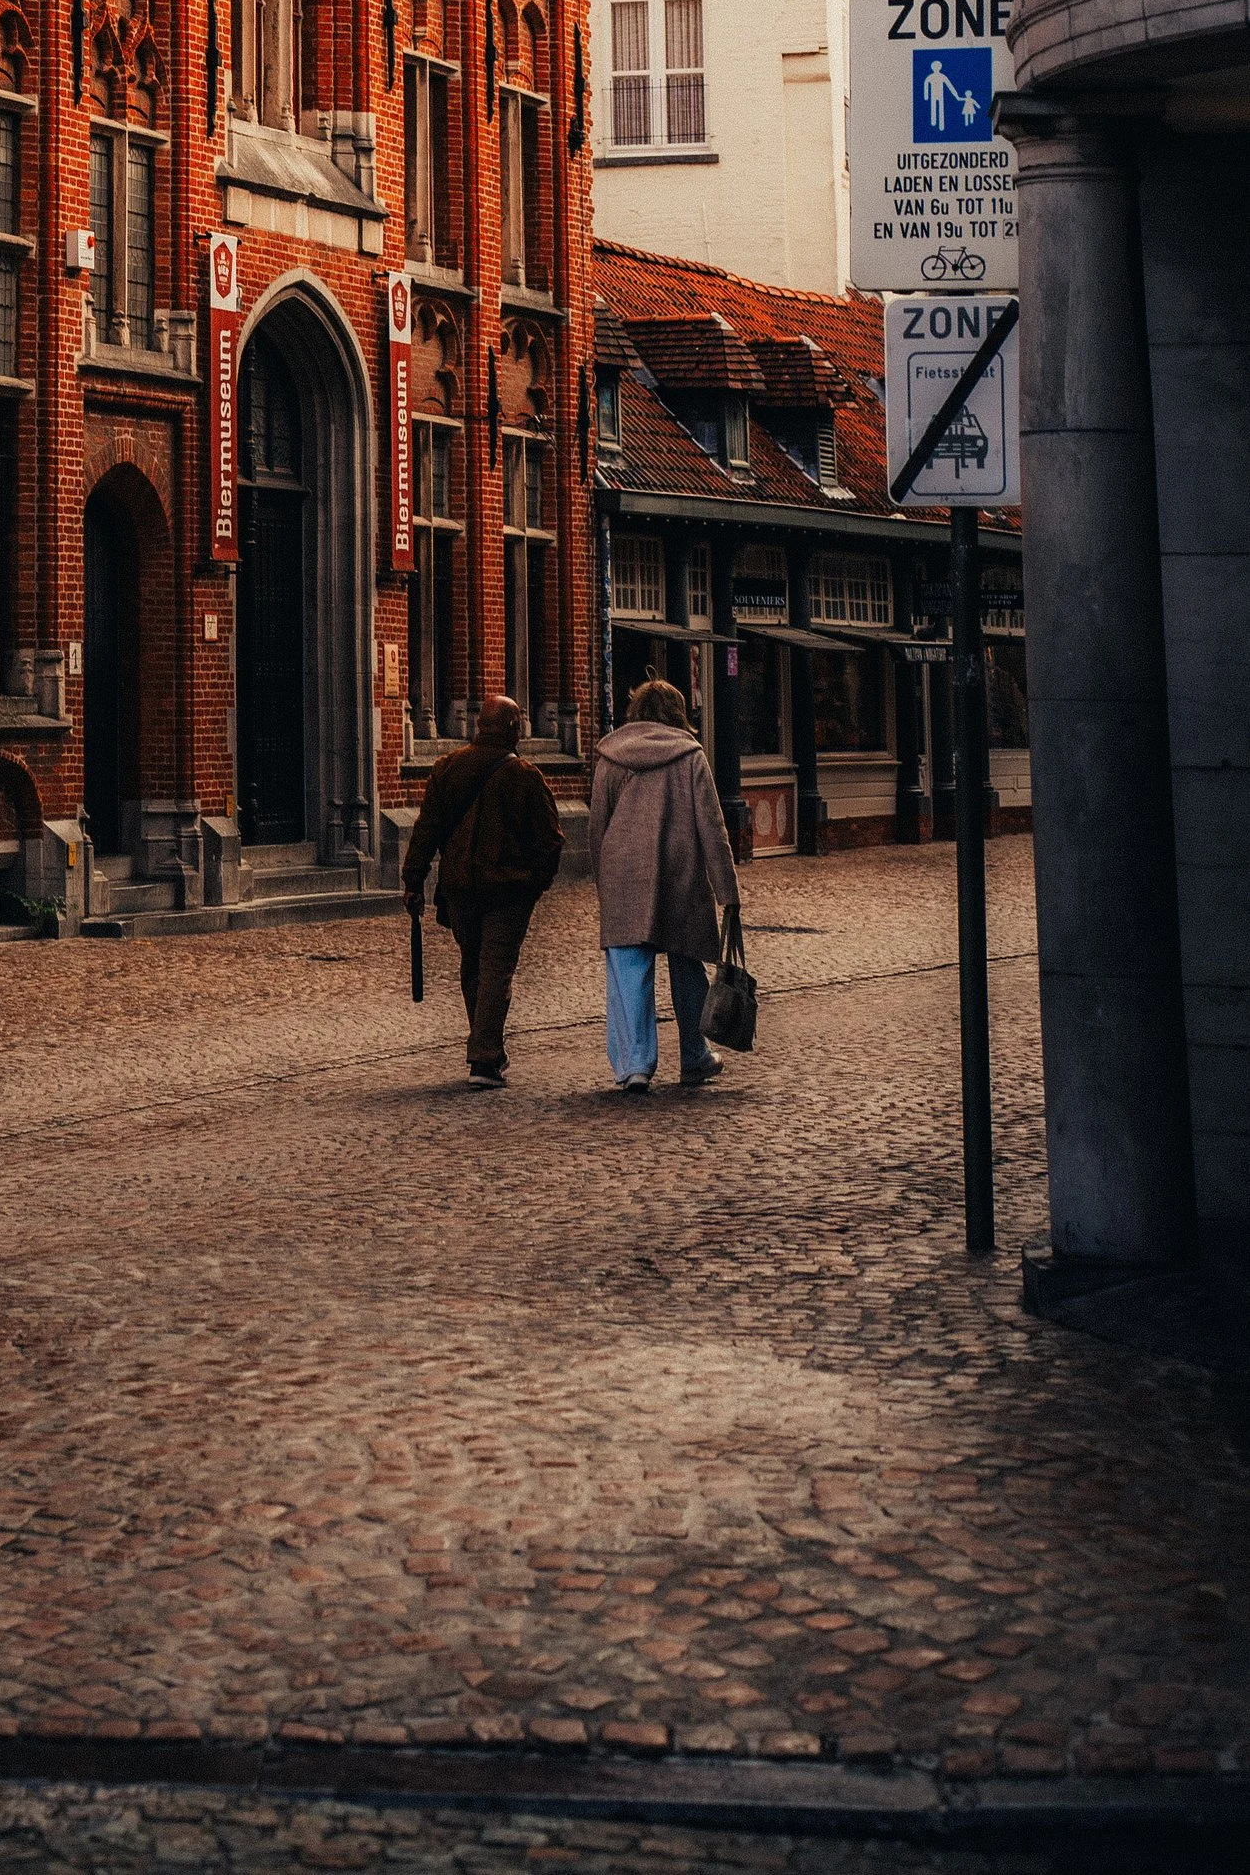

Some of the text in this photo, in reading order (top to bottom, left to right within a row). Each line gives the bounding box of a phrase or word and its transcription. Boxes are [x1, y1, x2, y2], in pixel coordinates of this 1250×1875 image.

[897, 151, 1009, 170] UITGEZONDERD
[884, 176, 933, 193] LADEN
[939, 175, 959, 192] EN
[894, 197, 1013, 216] VAN 6u TOT 11u
[873, 222, 893, 240] EN
[900, 221, 931, 239] VAN
[937, 221, 963, 238] 19u
[969, 221, 998, 238] TOT
[915, 366, 996, 380] Fietsstat
[215, 329, 232, 539] Biermuseum
[395, 359, 410, 553] Biermuseum
[733, 595, 786, 605] SOUVENIERS
[71, 648, 78, 670] 1
